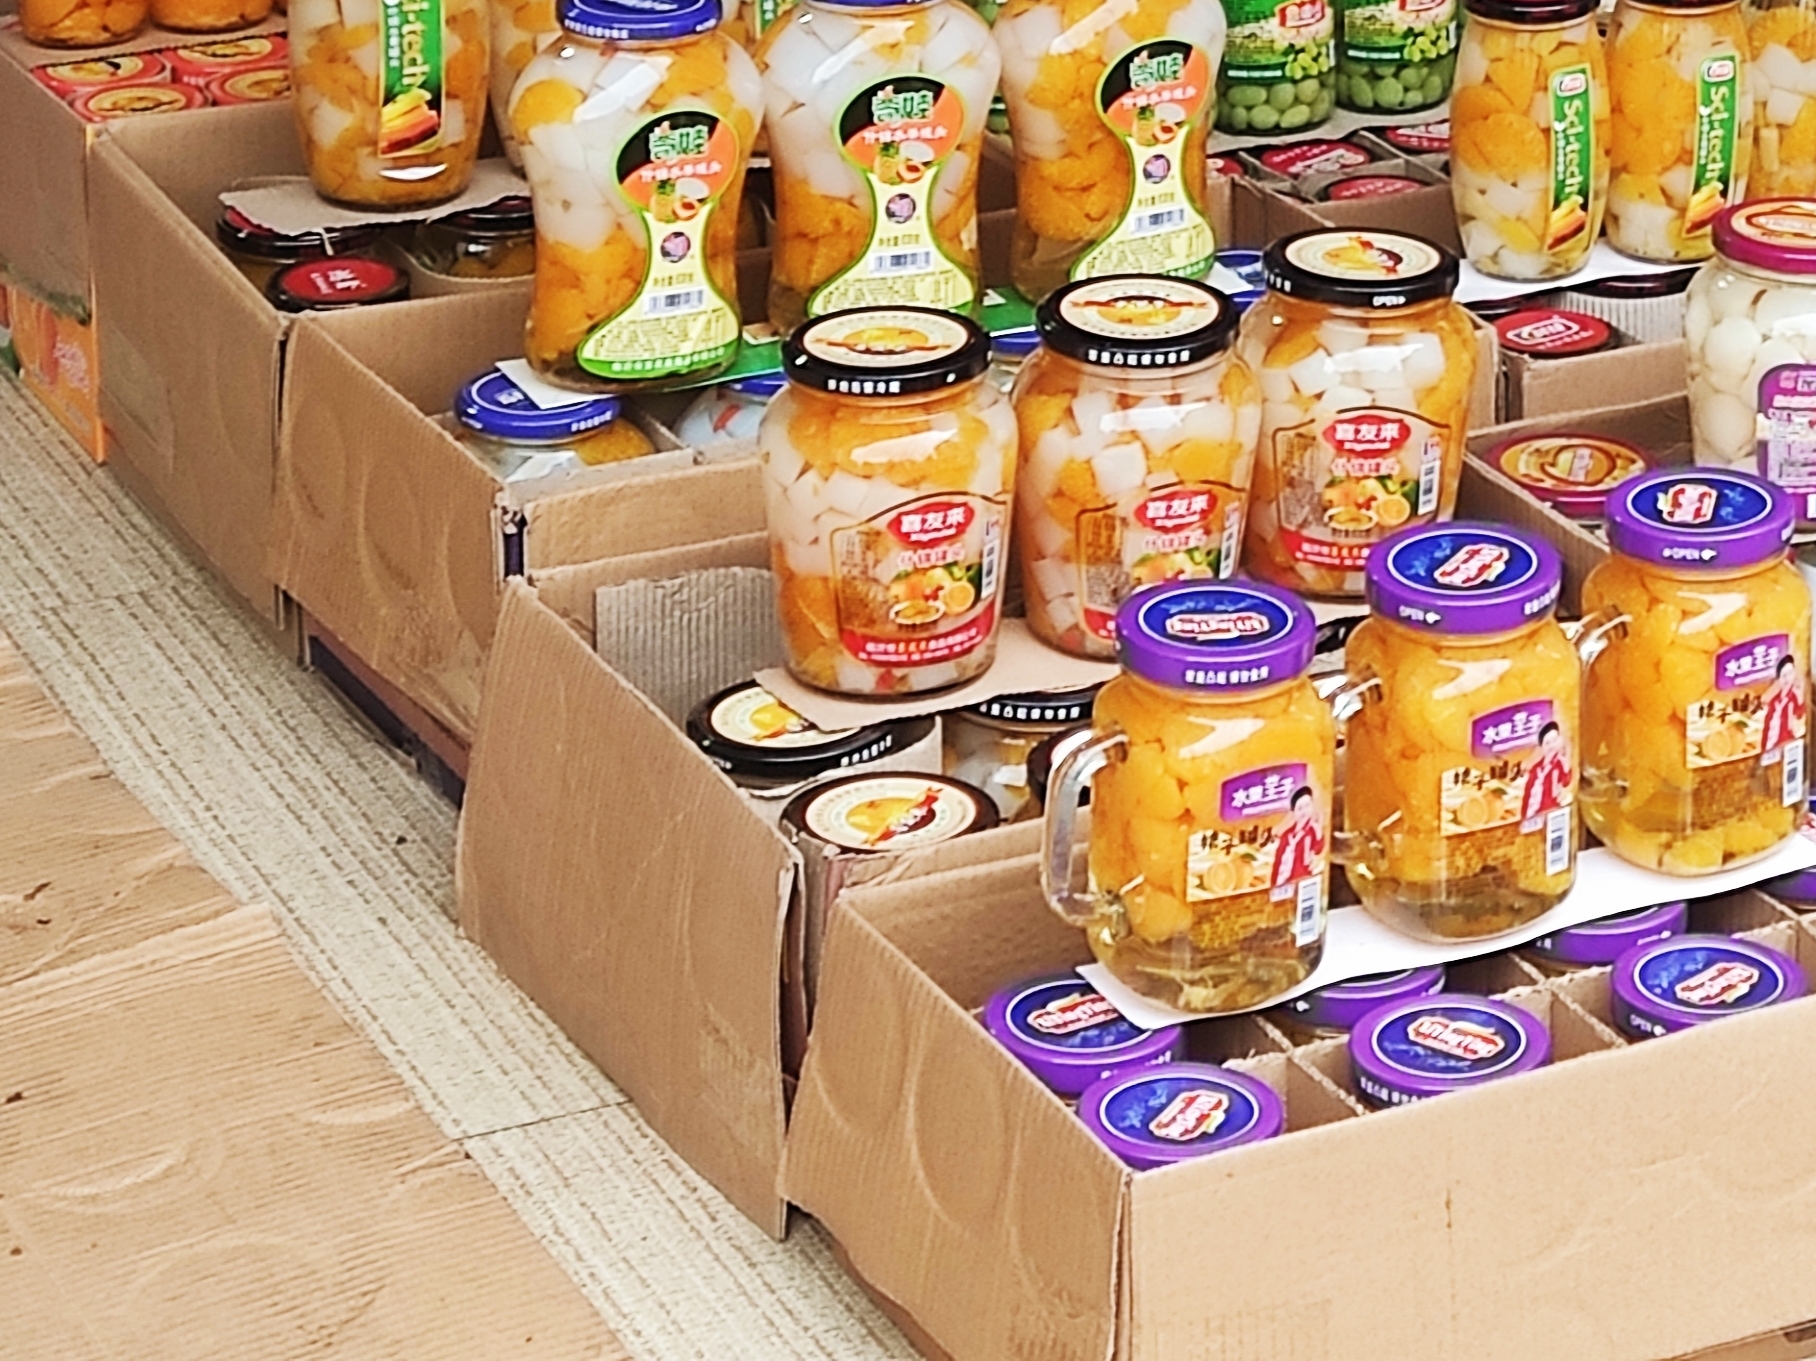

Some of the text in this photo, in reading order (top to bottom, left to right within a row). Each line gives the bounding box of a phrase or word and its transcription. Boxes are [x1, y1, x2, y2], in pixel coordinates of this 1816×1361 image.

[1335, 423, 1400, 442] 喜友来
[901, 507, 966, 533] 喜友来
[1232, 774, 1295, 809] 水果王子
